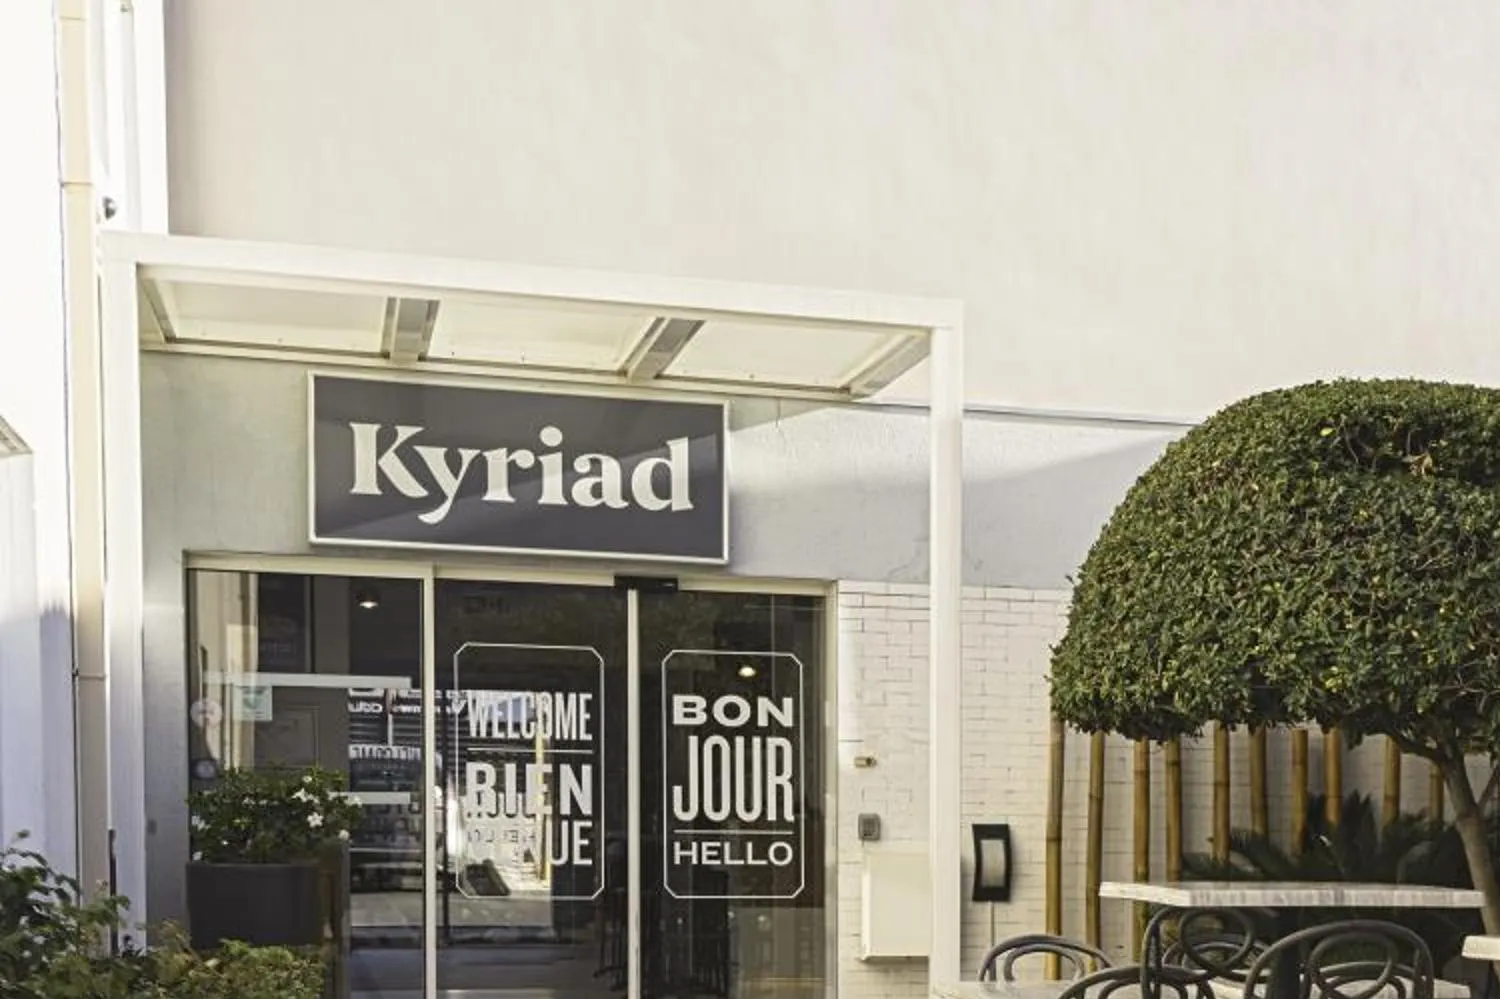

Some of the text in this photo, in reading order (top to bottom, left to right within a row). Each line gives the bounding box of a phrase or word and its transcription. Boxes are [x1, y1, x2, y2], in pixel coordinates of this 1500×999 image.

[349, 422, 694, 525] Kyriad
[466, 690, 593, 741] WELCOME
[672, 694, 794, 727] BON
[465, 762, 593, 816] BIEN
[672, 735, 795, 822] JOUR
[673, 841, 793, 866] HELLO
